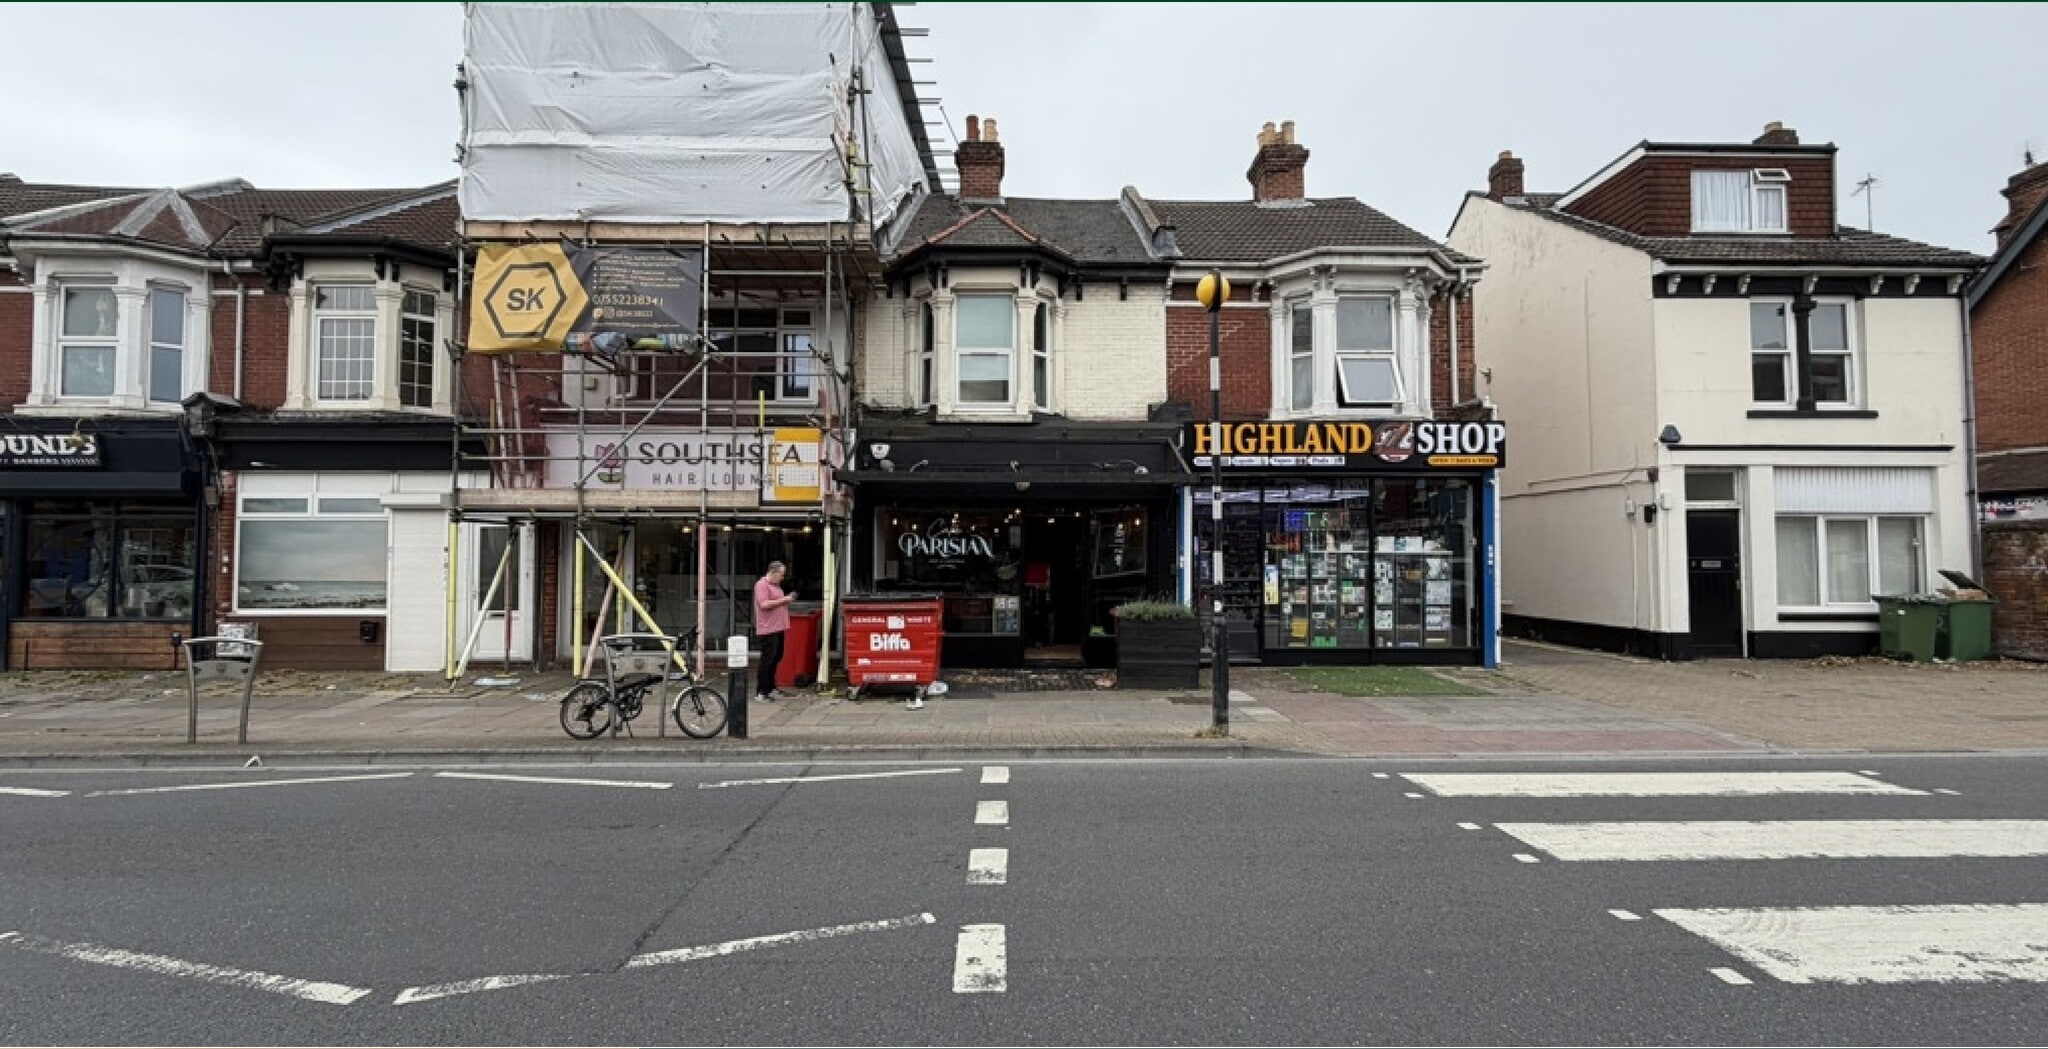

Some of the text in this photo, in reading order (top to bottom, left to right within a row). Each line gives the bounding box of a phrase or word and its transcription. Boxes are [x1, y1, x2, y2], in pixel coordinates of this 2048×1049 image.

[506, 286, 546, 312] SK
[0, 434, 97, 455] UNDS
[1194, 421, 1505, 455] HIGHLAND SHOP
[638, 441, 802, 466] SOUTHSEA
[652, 472, 785, 486] HAIR LOUNGE
[898, 531, 994, 558] PARISIAN
[869, 631, 911, 652] Biffa
